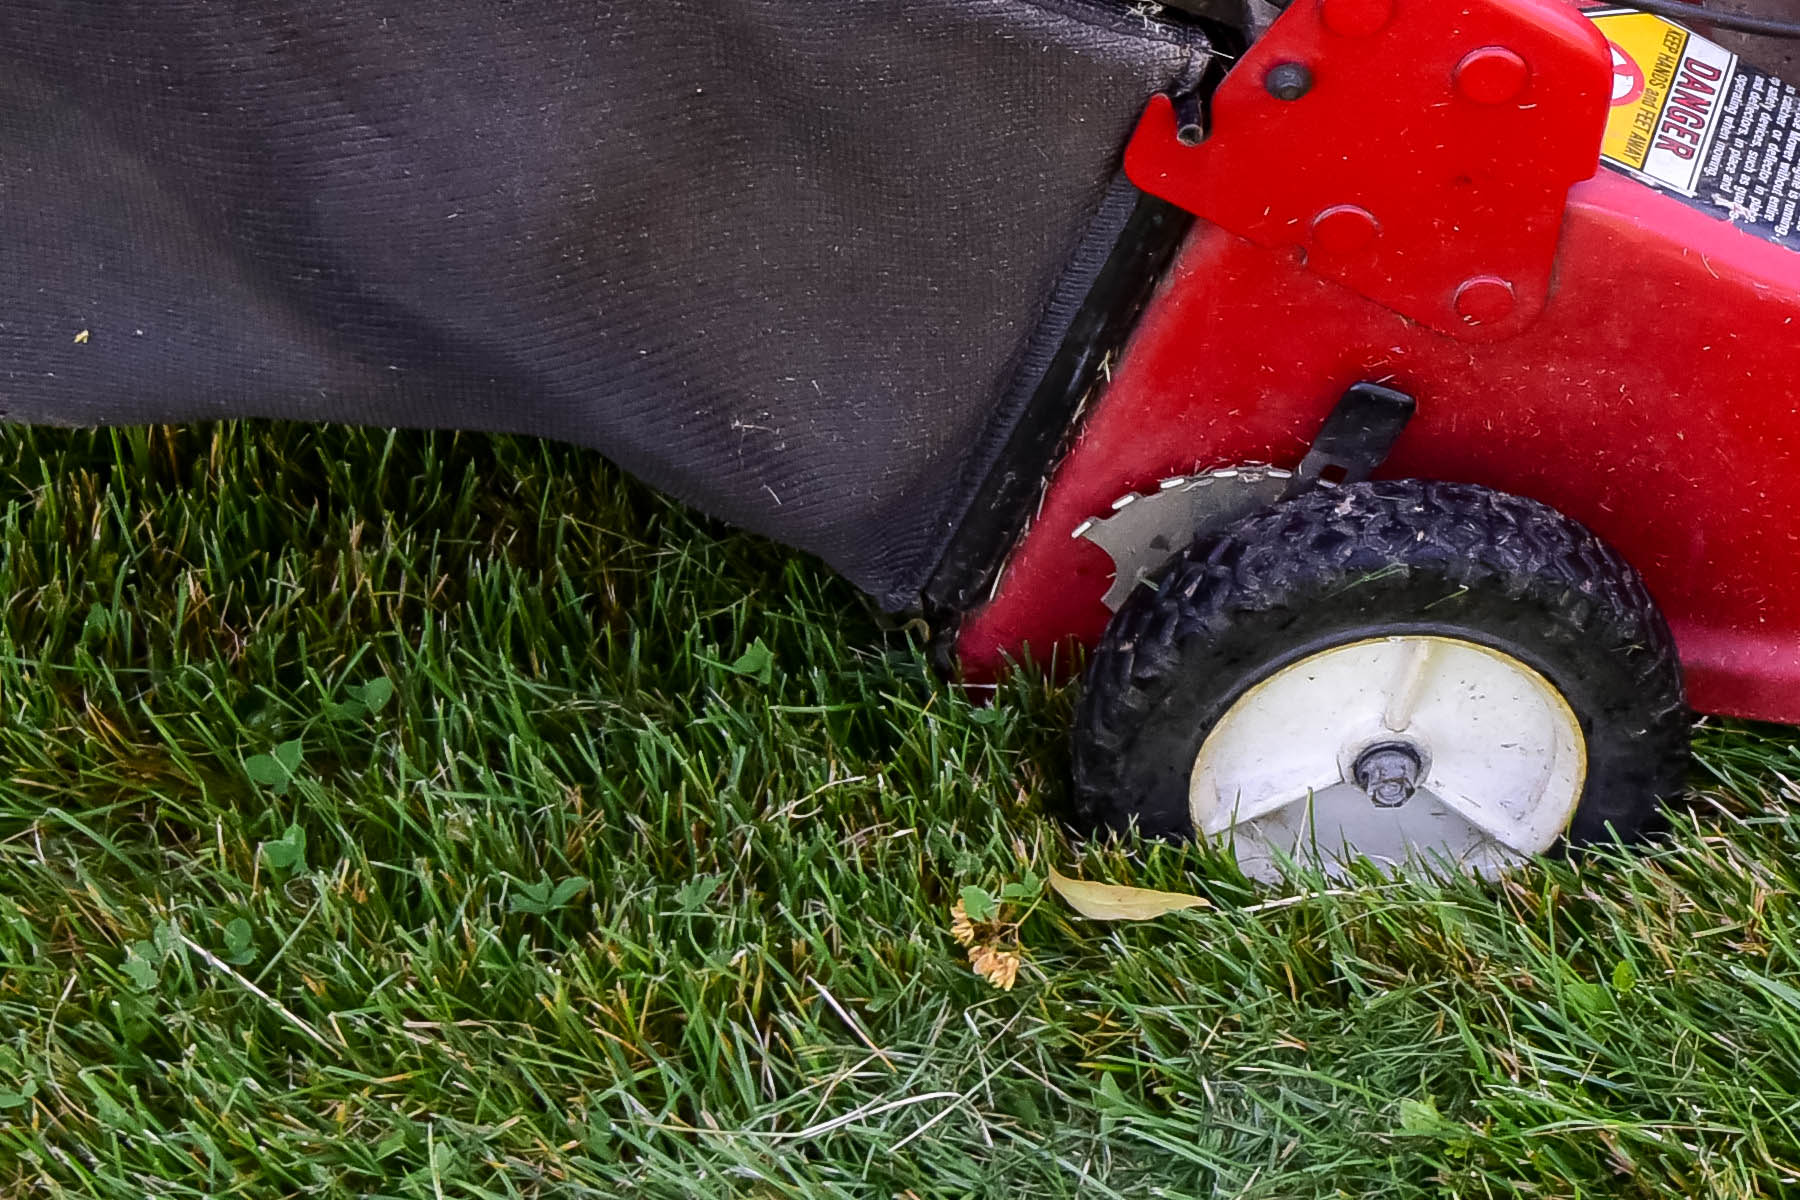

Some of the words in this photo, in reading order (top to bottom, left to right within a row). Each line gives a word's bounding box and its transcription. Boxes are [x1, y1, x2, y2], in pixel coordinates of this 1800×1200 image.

[1663, 28, 1683, 54] KEEP
[1649, 53, 1674, 89] HANDS
[1753, 75, 1764, 92] and
[1642, 88, 1659, 109] and
[1657, 58, 1720, 159] DANGER
[1724, 75, 1747, 115] operating
[1759, 86, 1778, 111] safety
[1633, 108, 1655, 134] FEET
[1736, 92, 1760, 135] deflectors,
[1776, 95, 1793, 127] catcher
[1719, 116, 1734, 140] when
[1750, 112, 1772, 147] devices,
[1772, 130, 1782, 141] or
[1624, 131, 1646, 163] AWAY
[1734, 138, 1747, 148] in
[1704, 141, 1726, 176] mowing.
[1725, 147, 1741, 174] place
[1744, 150, 1758, 173] such
[1759, 143, 1780, 183] deflector
[1720, 174, 1733, 193] and
[1739, 174, 1751, 186] as
[1754, 185, 1768, 195] in
[1772, 162, 1790, 196] without
[1727, 185, 1747, 219] guas
[1743, 196, 1762, 223] place.
[1764, 196, 1779, 221] entire
[1774, 200, 1795, 237] running.
